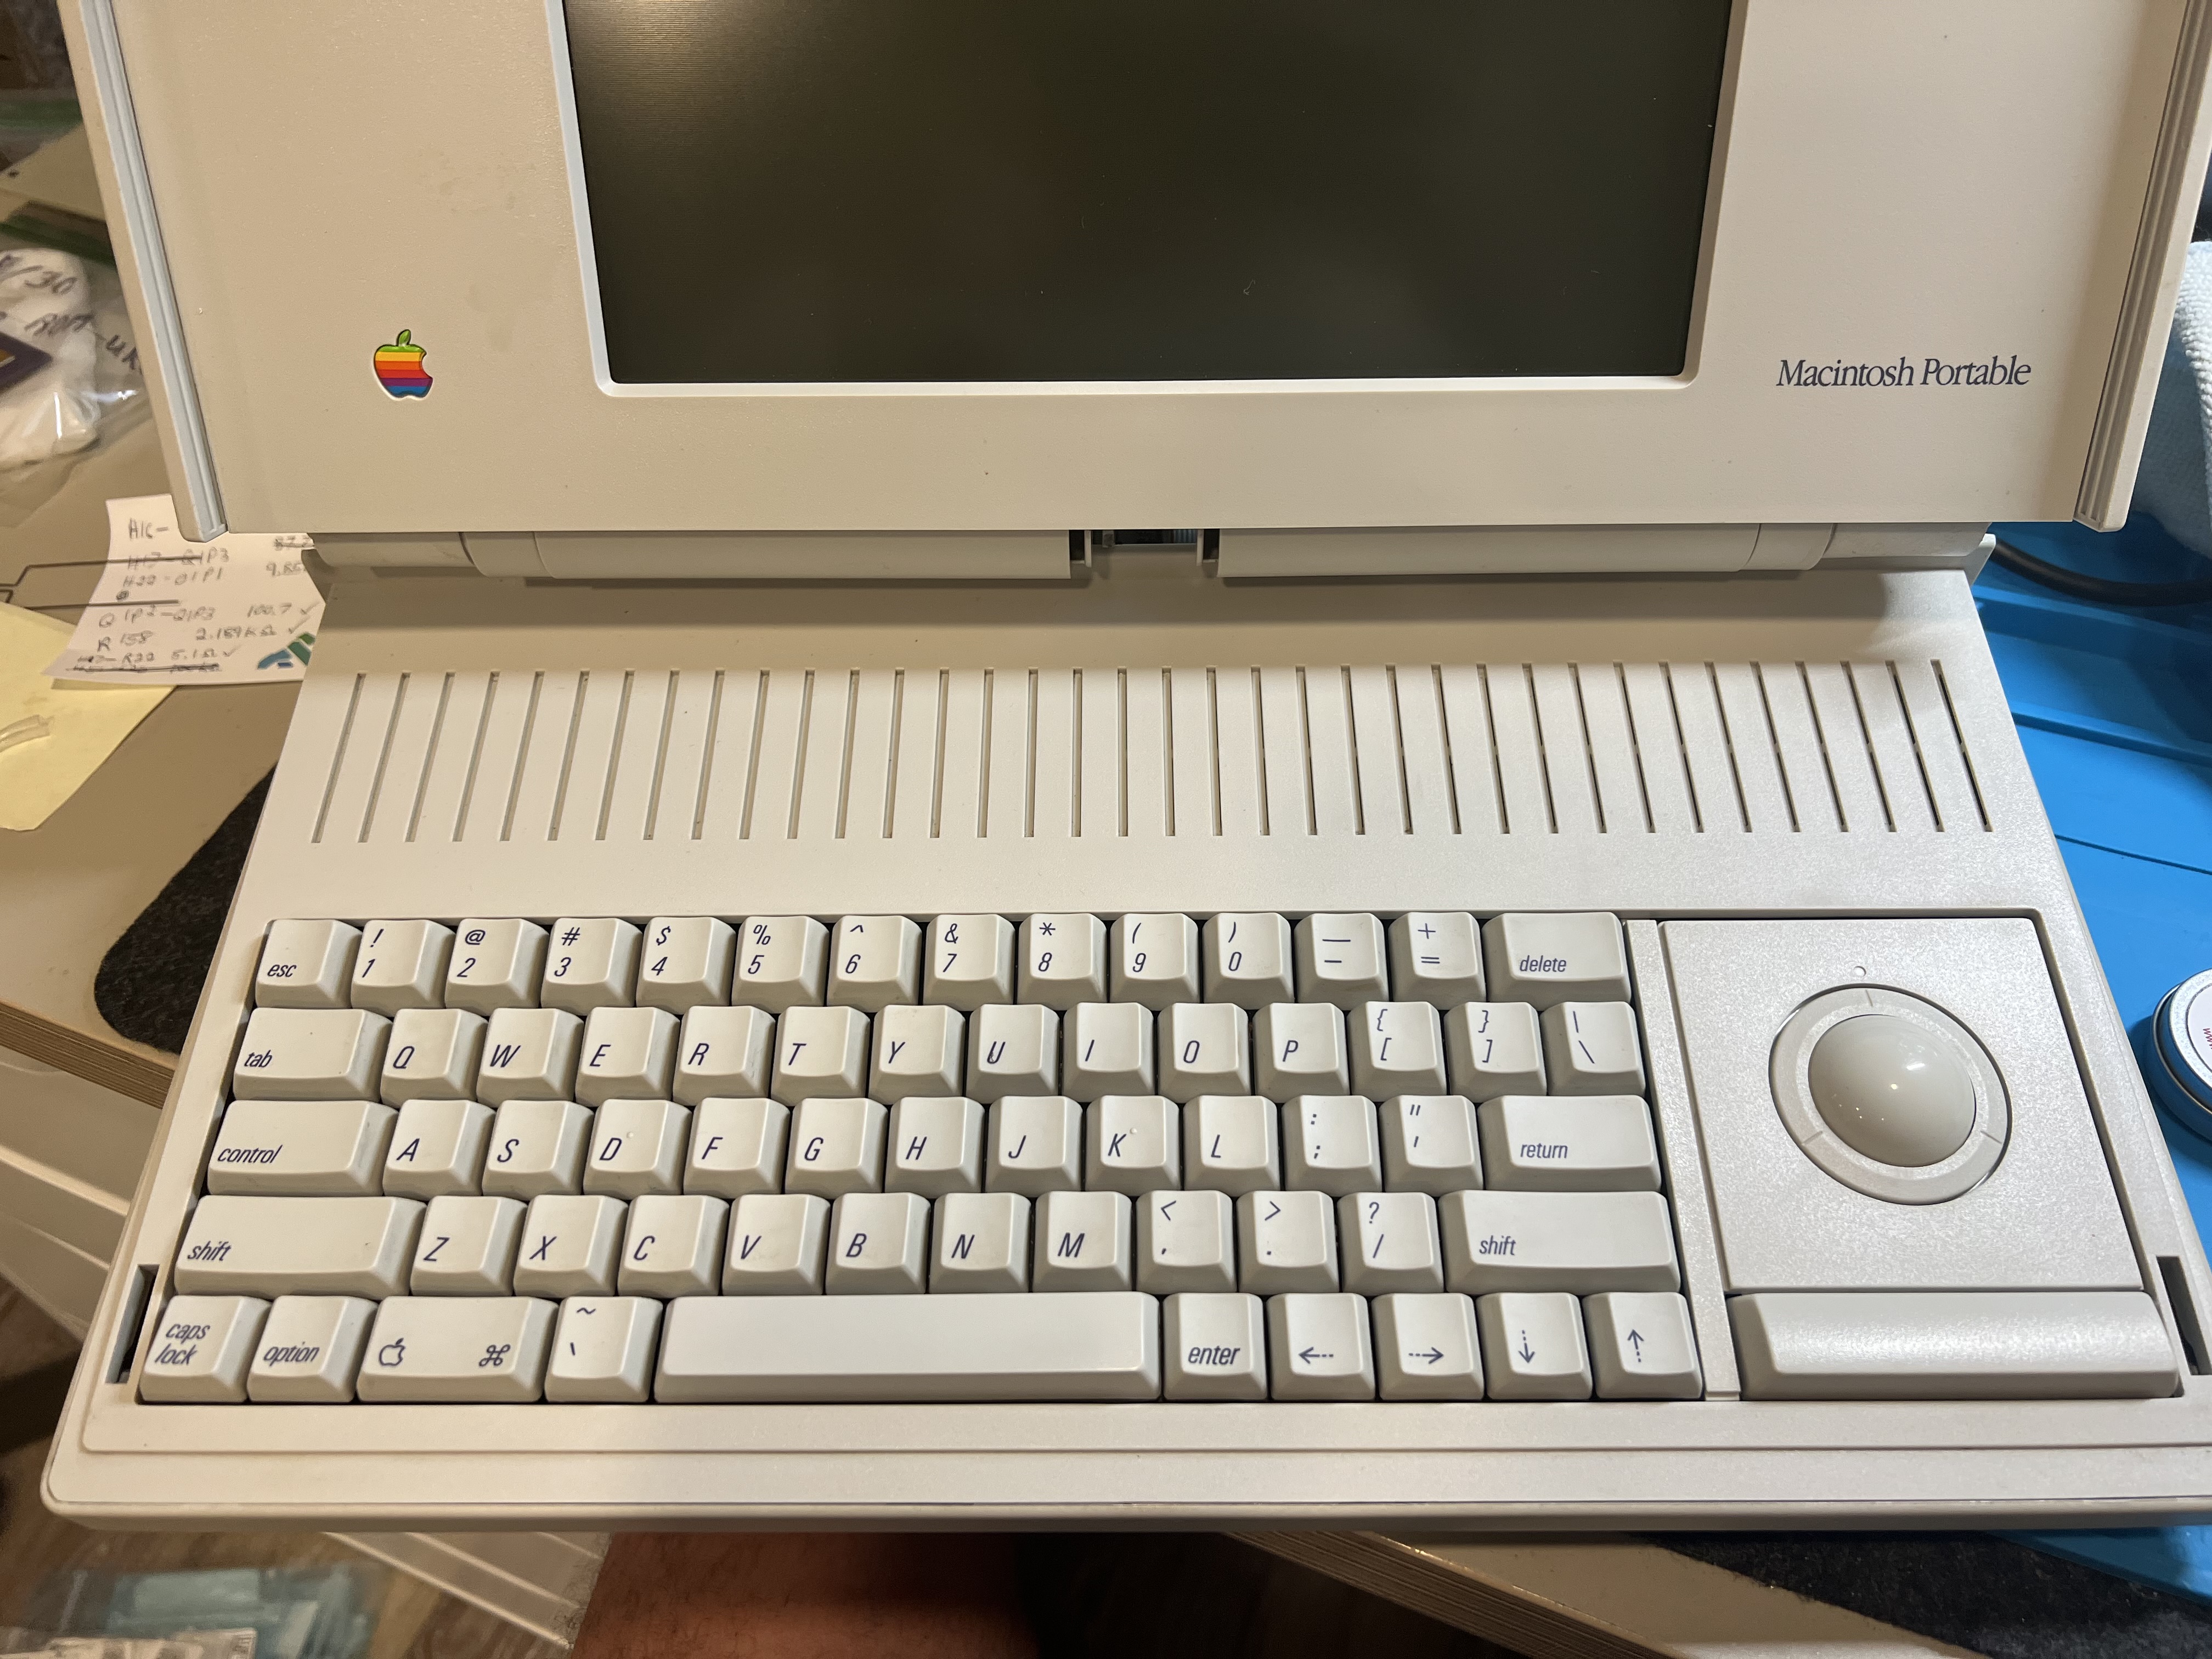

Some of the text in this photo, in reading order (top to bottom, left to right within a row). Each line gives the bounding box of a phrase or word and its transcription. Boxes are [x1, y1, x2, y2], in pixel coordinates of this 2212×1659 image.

[1775, 354, 2032, 387] Macintosh Portable
[370, 928, 384, 947] !
[465, 929, 486, 945] @
[561, 927, 580, 946] #
[656, 926, 672, 946] $
[753, 924, 771, 945] %
[944, 923, 958, 944] &
[1132, 922, 1142, 944] (
[1228, 921, 1237, 943] )
[1417, 923, 1436, 940] +
[267, 964, 297, 978] esc
[362, 958, 376, 978] 1
[456, 957, 476, 978] 2
[554, 957, 572, 977] 3
[651, 956, 668, 976] 4
[747, 955, 765, 974] 5
[845, 954, 861, 974] 6
[943, 953, 957, 973] 7
[1038, 952, 1053, 972] 8
[1132, 952, 1147, 973] 9
[1228, 951, 1242, 972] 0
[1519, 955, 1567, 973] delete
[1376, 1008, 1388, 1032] {
[1478, 1009, 1489, 1033] }
[244, 1050, 273, 1068] tab
[392, 1046, 415, 1069] Q
[489, 1044, 521, 1068] W
[589, 1044, 611, 1067] E
[687, 1042, 709, 1066] R
[788, 1042, 807, 1066] T
[888, 1041, 906, 1064] Y
[986, 1041, 1006, 1064] U
[1085, 1039, 1095, 1062] I
[1183, 1040, 1200, 1064] O
[1282, 1040, 1299, 1062] P
[1380, 1037, 1392, 1061] [
[1482, 1039, 1493, 1063] ]
[217, 1143, 283, 1164] control
[396, 1138, 420, 1162] A
[496, 1138, 520, 1163] S
[599, 1137, 622, 1161] D
[701, 1137, 724, 1160] F
[804, 1137, 824, 1161] G
[905, 1136, 927, 1160] H
[1008, 1135, 1026, 1159] J
[1108, 1133, 1127, 1158] K
[1210, 1134, 1221, 1158] L
[1520, 1143, 1568, 1159] return
[1160, 1200, 1177, 1221] <
[1264, 1201, 1281, 1221] >
[1369, 1201, 1380, 1224] ?
[187, 1240, 232, 1261] shift
[423, 1236, 450, 1262] Z
[529, 1235, 557, 1261] X
[633, 1235, 656, 1261] C
[740, 1234, 762, 1260] V
[845, 1233, 867, 1258] B
[951, 1234, 975, 1260] N
[1057, 1232, 1085, 1258] M
[1479, 1235, 1516, 1256] shift
[165, 1323, 211, 1344] caps
[154, 1344, 198, 1365] lock
[263, 1341, 320, 1367] option
[1188, 1345, 1241, 1365] enter
